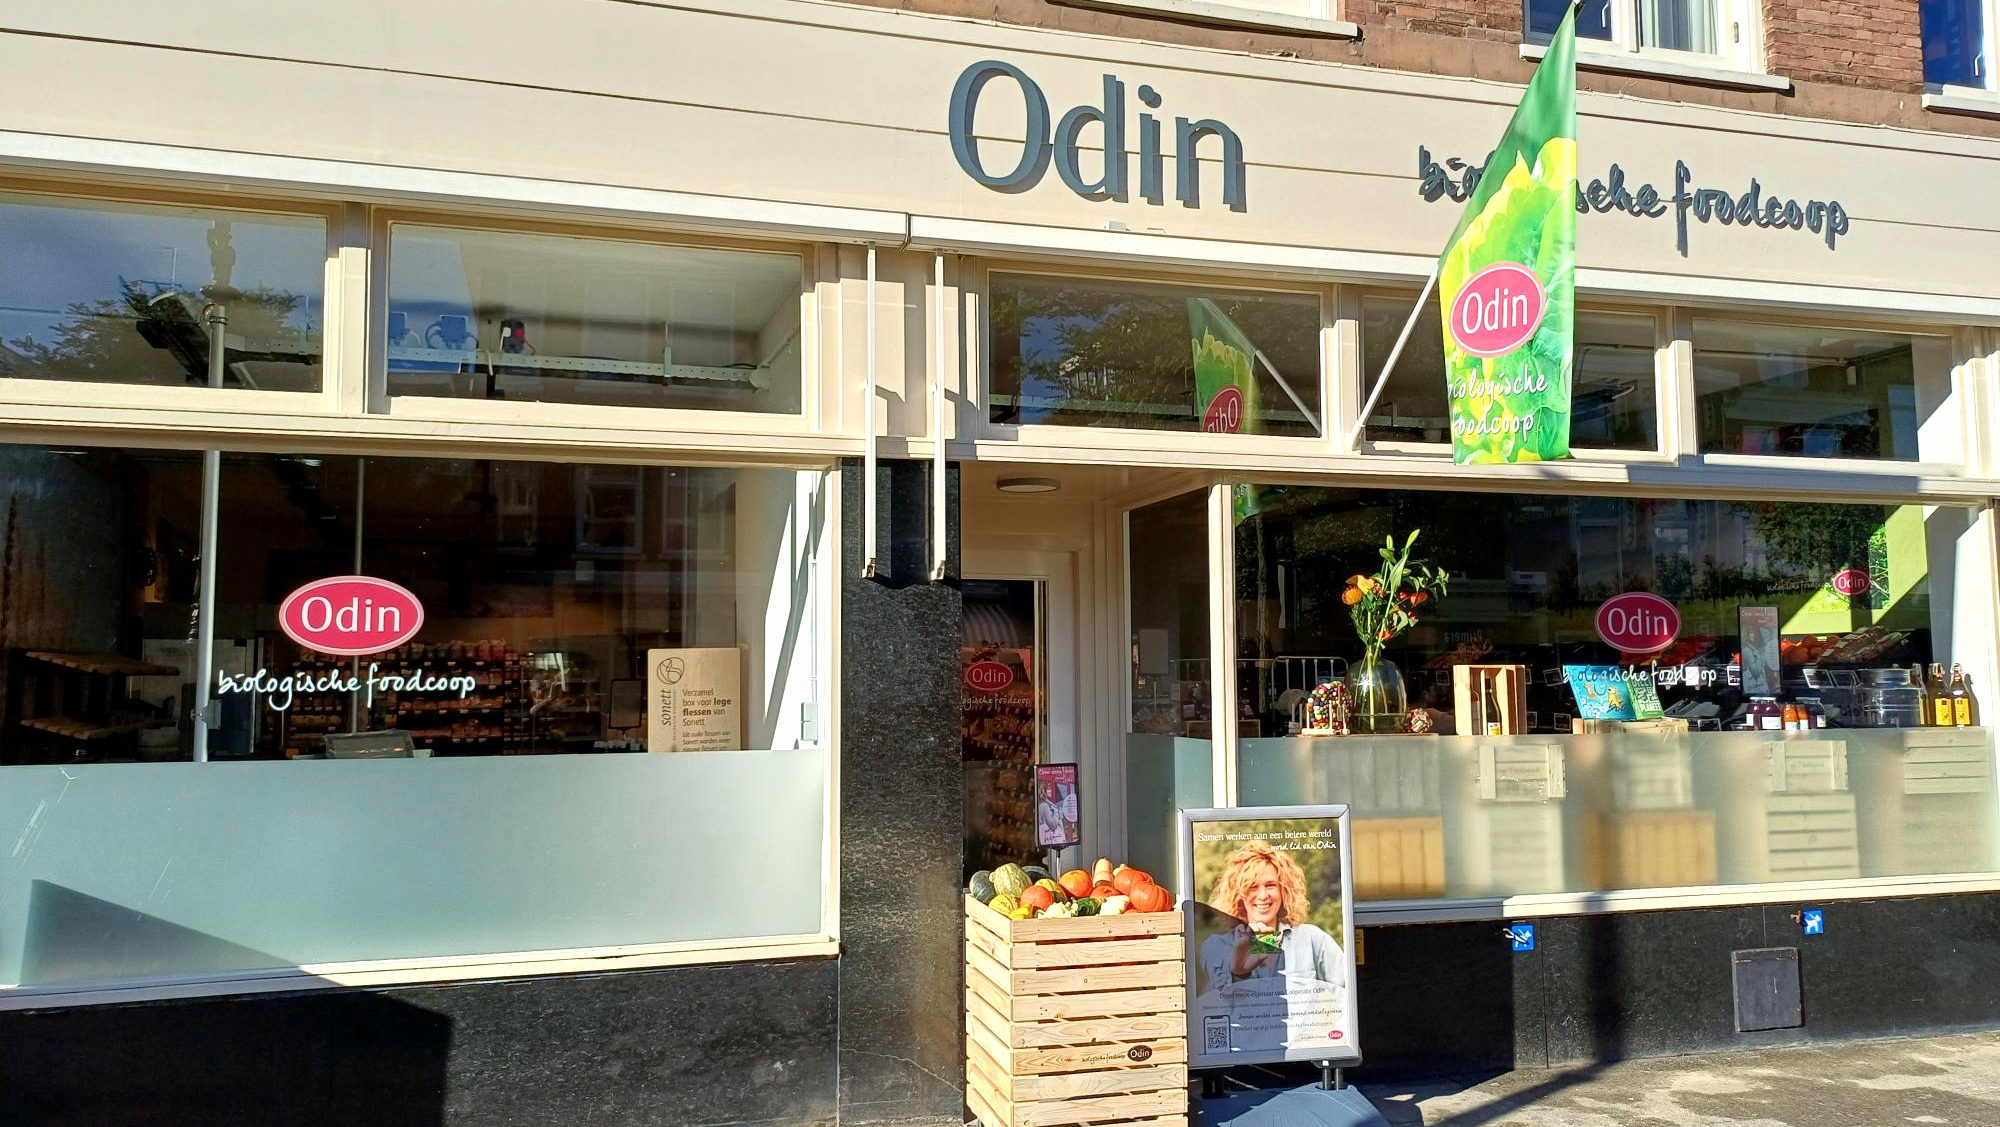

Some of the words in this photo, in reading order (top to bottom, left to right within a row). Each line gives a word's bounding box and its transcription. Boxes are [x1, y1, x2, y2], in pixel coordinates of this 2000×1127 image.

[949, 60, 1245, 211] Odin
[1674, 159, 1849, 258] foodcoop
[1462, 288, 1529, 334] Odin
[1838, 576, 1865, 589] Odin
[301, 596, 401, 632] Odin
[1607, 607, 1668, 636] Odin
[972, 668, 1006, 683] Odin
[218, 668, 361, 711] biologische
[367, 662, 476, 708] foodcoop
[682, 688, 714, 696] Verzamel
[661, 688, 671, 726] sonett
[713, 698, 732, 707] lege
[682, 708, 712, 716] flessen
[682, 719, 705, 727] Sonett
[1198, 832, 1224, 841] Samen
[1226, 831, 1252, 840] werken
[1285, 830, 1307, 839] betere
[1309, 829, 1332, 838] wereld
[1271, 842, 1288, 851] word
[1290, 841, 1302, 850] lid
[1317, 841, 1337, 849] Odin
[1130, 1049, 1150, 1058] Odin
